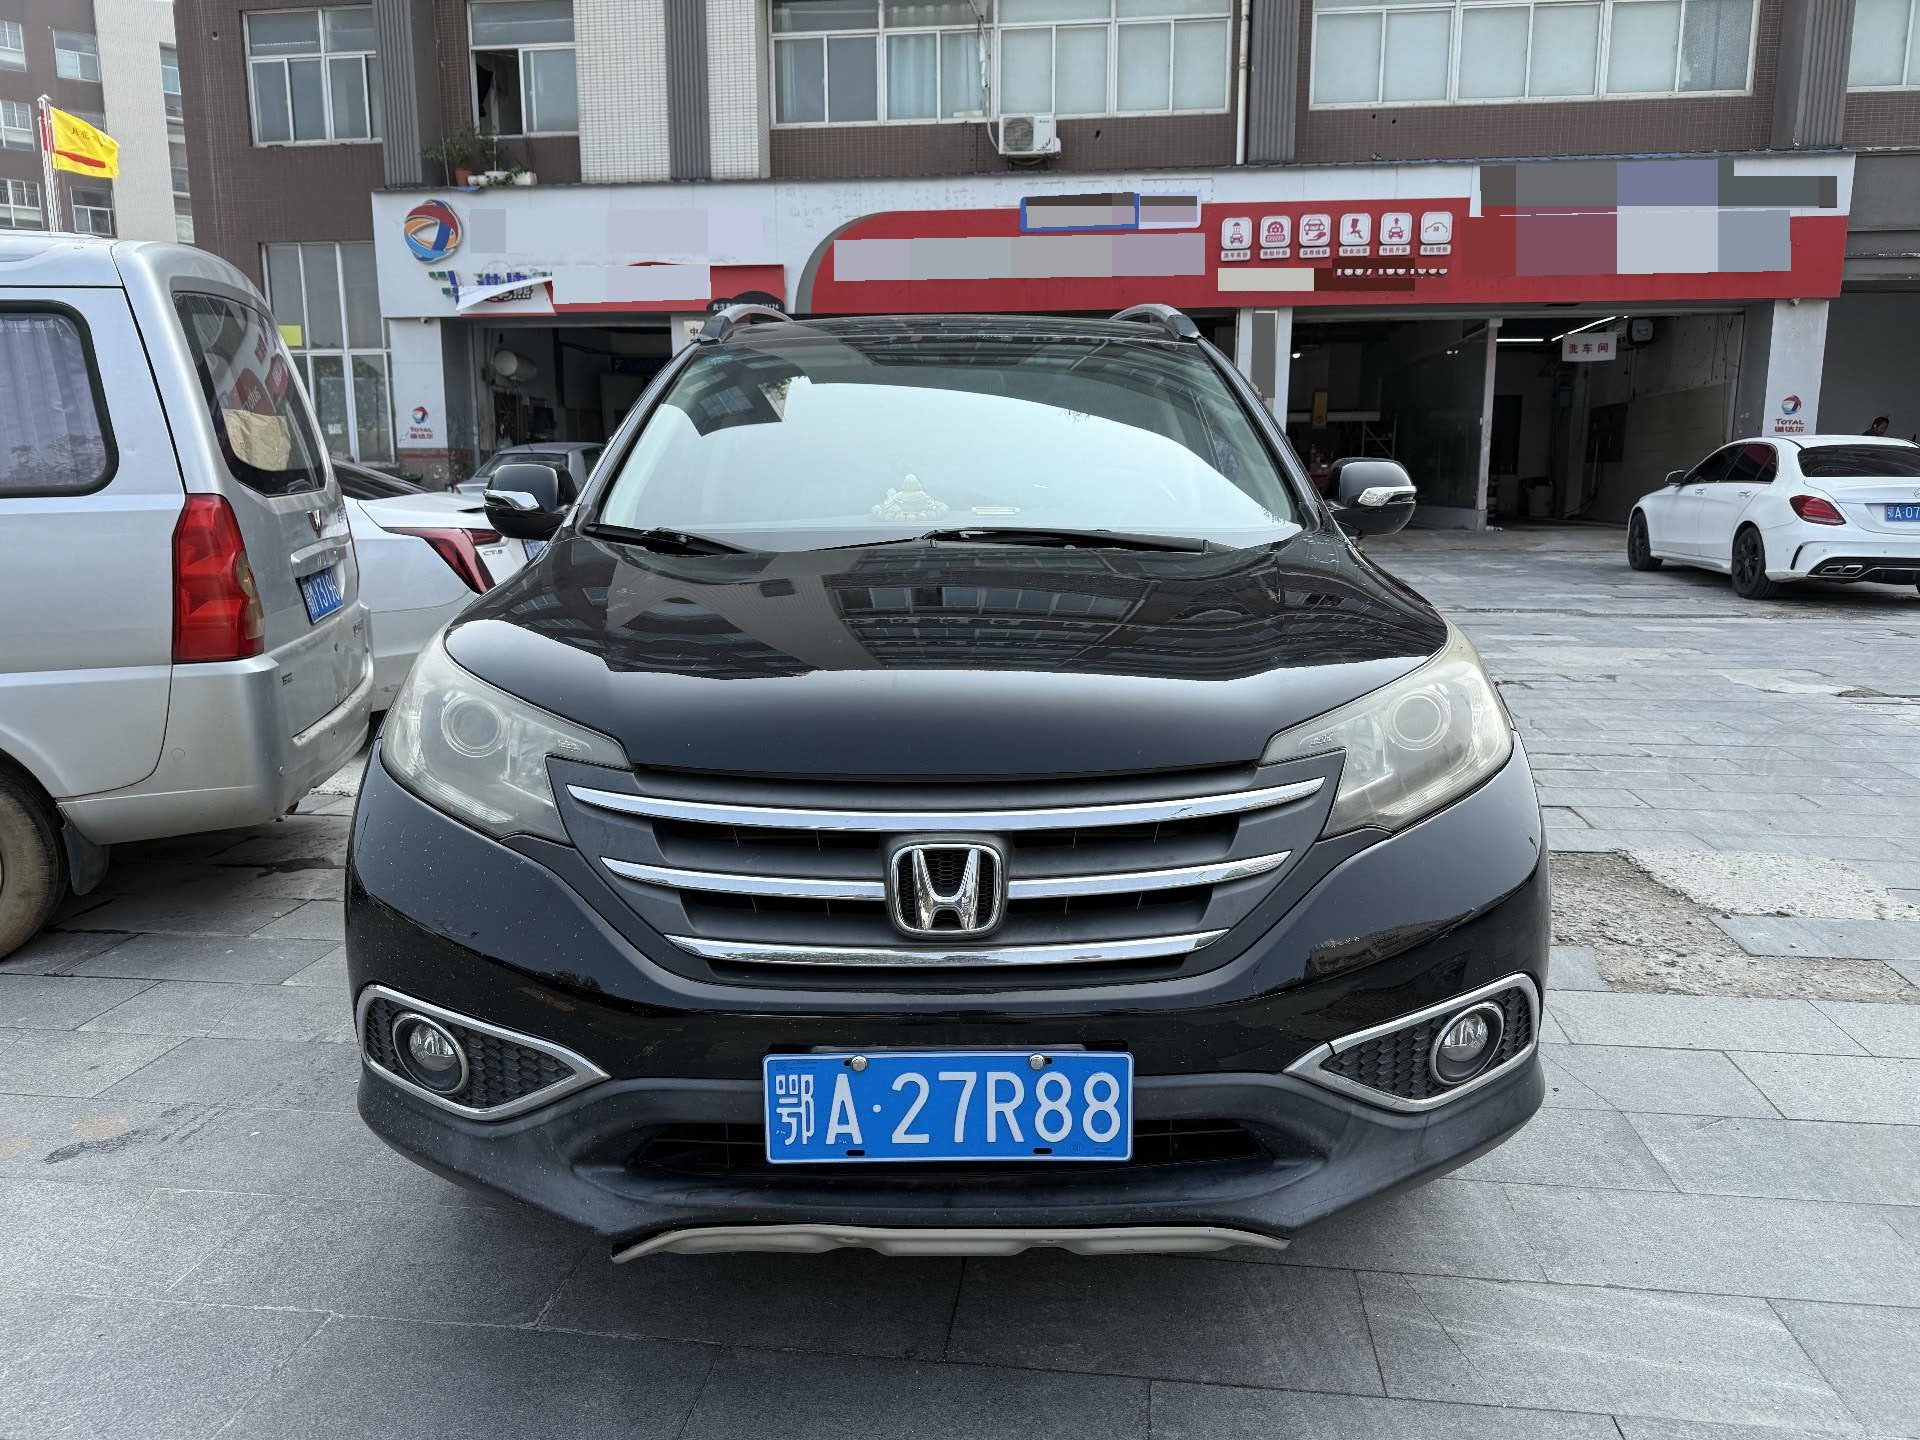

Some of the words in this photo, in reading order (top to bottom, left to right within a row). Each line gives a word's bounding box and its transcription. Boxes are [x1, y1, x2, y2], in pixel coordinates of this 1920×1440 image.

[1568, 342, 1609, 354] 洗车间
[775, 1071, 1121, 1146] 鄂A·27R88
